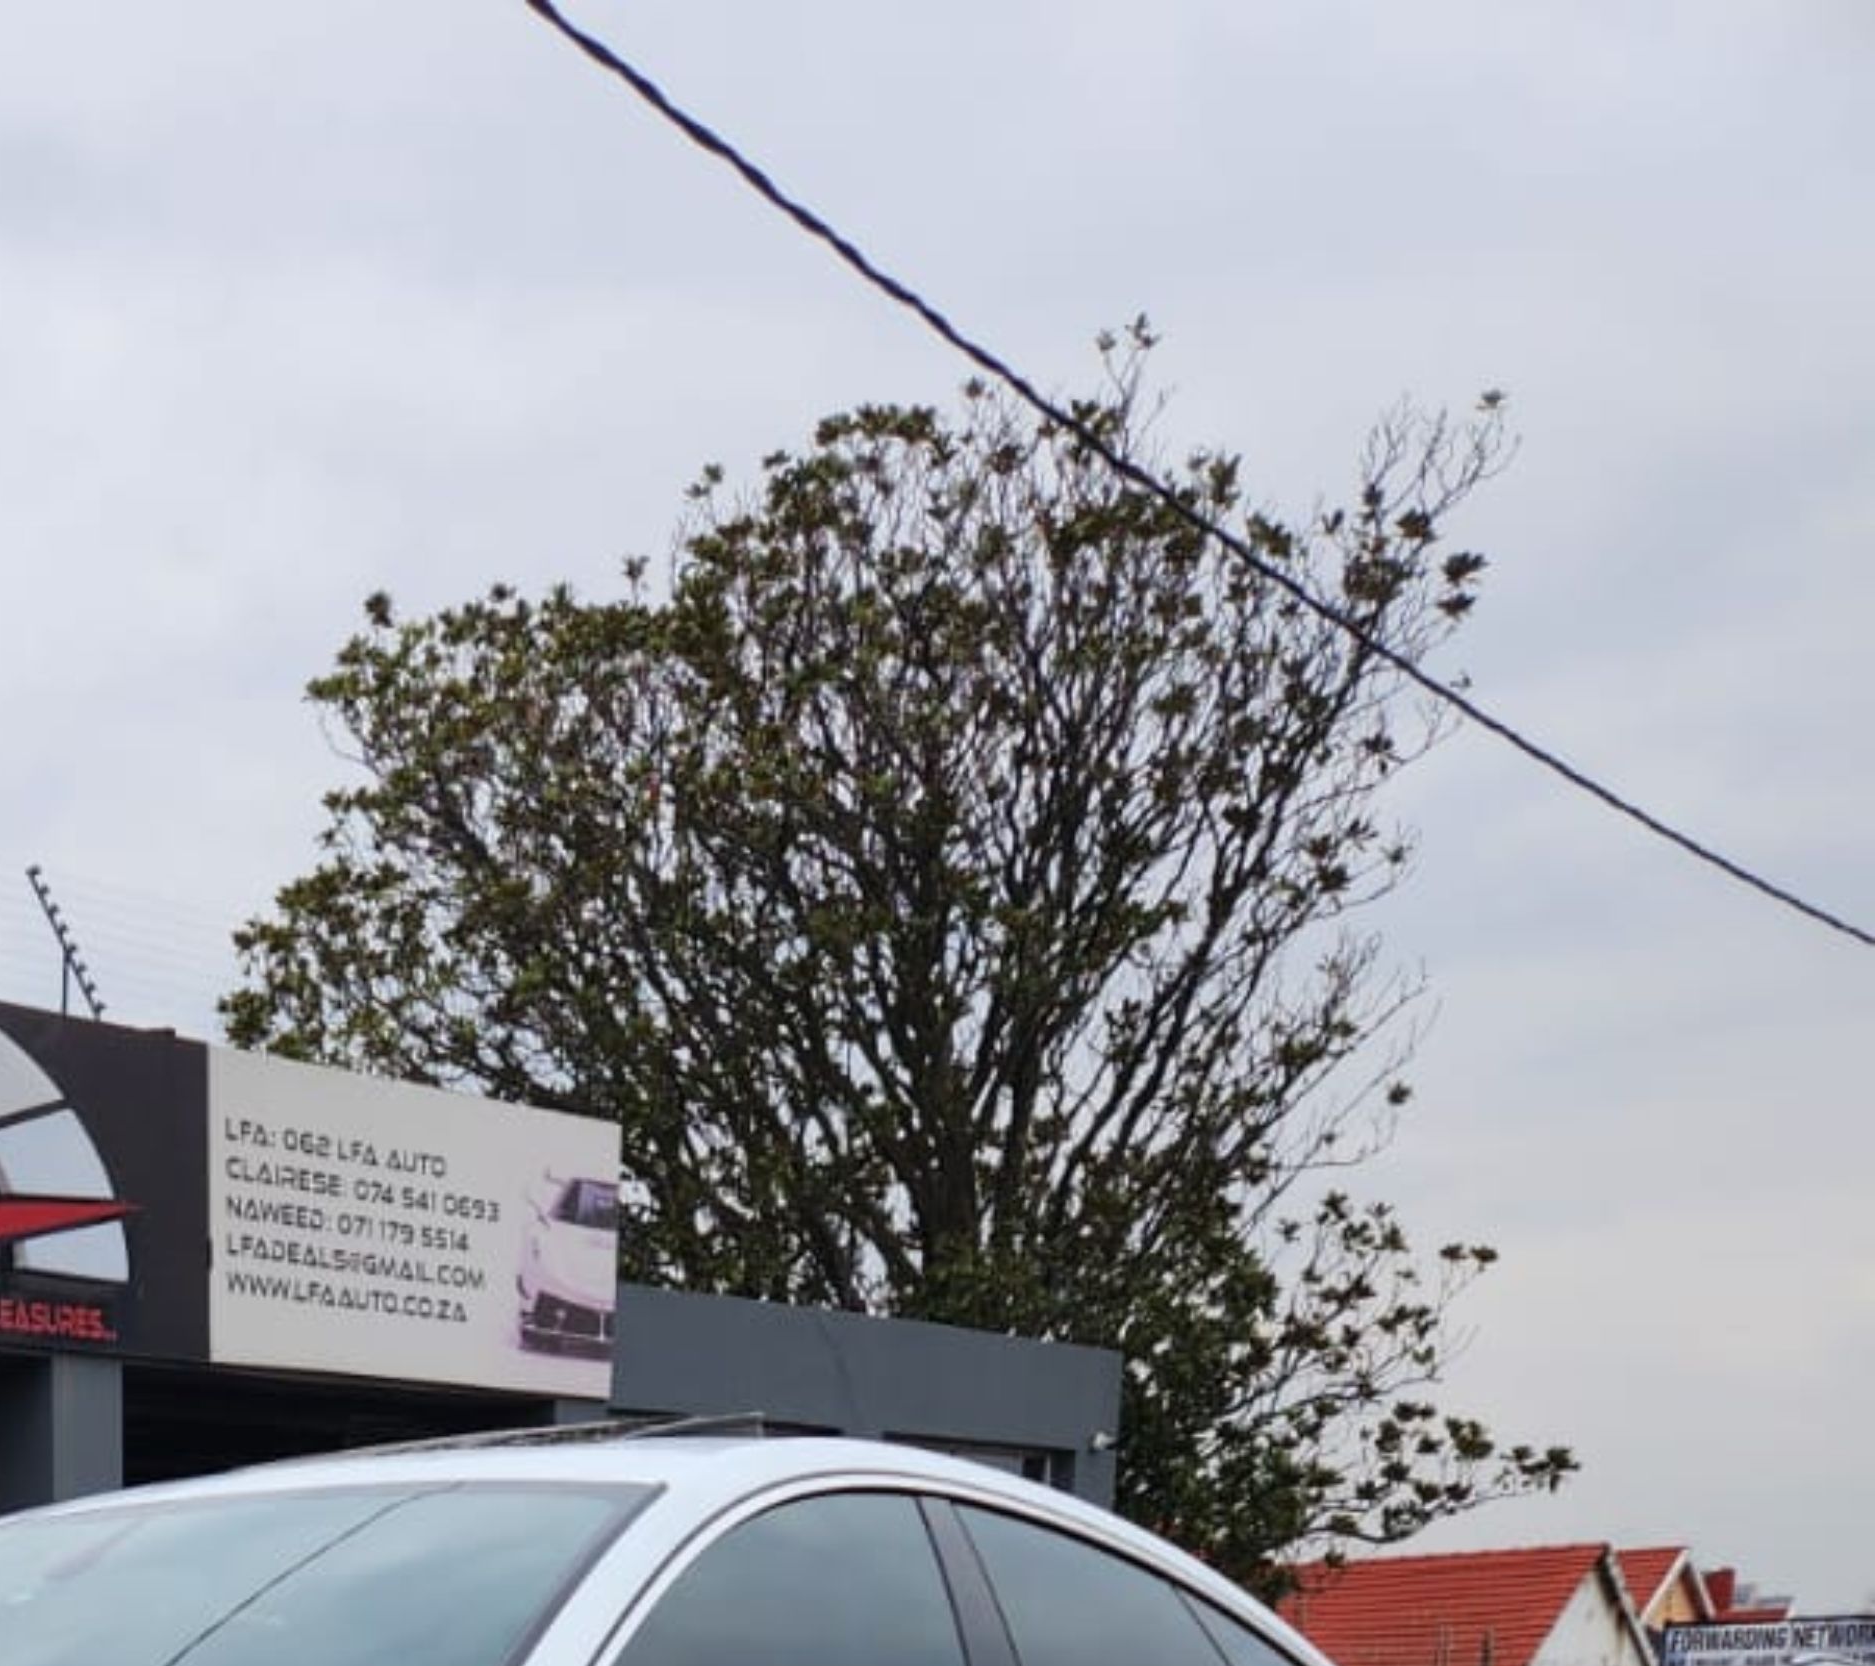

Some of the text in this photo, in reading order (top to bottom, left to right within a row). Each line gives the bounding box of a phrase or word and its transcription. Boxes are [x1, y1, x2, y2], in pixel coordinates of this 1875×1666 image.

[225, 1117, 448, 1179] LFA: 062 LFA AUTO
[353, 1178, 396, 1205] 074
[402, 1186, 437, 1212] 541
[337, 1213, 374, 1238] 071
[379, 1219, 415, 1245] 179
[421, 1226, 470, 1252] 5514
[1671, 1621, 1875, 1652] FORWARDING NETWOR
